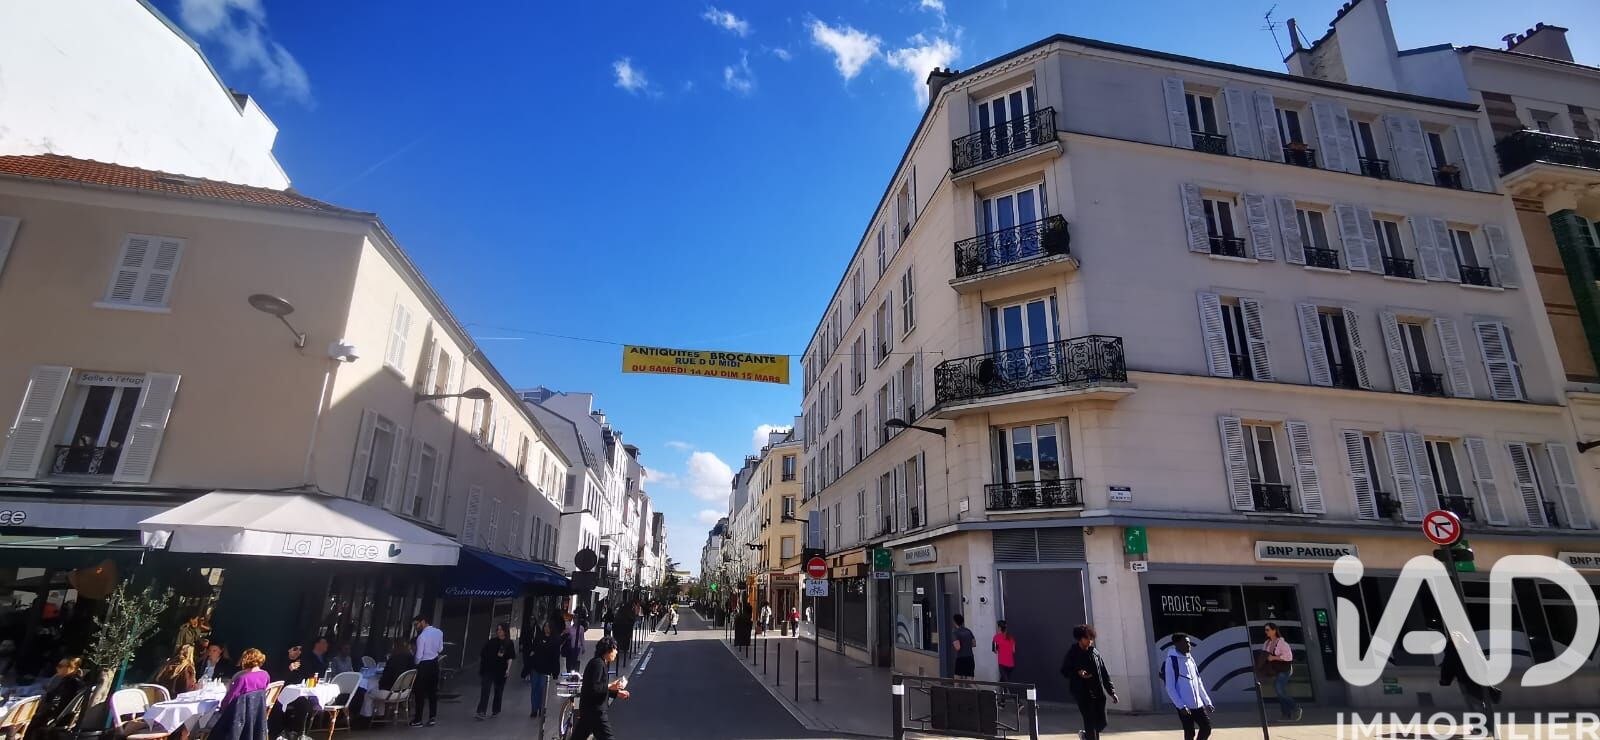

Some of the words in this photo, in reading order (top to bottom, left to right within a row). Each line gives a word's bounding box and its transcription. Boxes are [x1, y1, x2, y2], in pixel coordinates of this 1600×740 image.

[630, 347, 700, 358] ANTIQUITES
[710, 352, 776, 364] BROCANTE
[675, 357, 696, 365] RUE
[719, 360, 741, 368] MIDI
[81, 374, 104, 382] Salle
[632, 364, 646, 372] DU
[649, 365, 687, 374] SAMEDI
[703, 369, 718, 377] AU
[720, 370, 738, 379] DIM
[742, 372, 752, 380] 15
[754, 373, 781, 383] MARS
[282, 533, 312, 555] La
[320, 536, 379, 559] Place
[1266, 546, 1293, 555] BNP
[1296, 547, 1350, 557] PARIBAS
[1569, 556, 1592, 565] BNP
[445, 586, 513, 596] Poissonnerie
[1161, 595, 1202, 612] PROJETS
